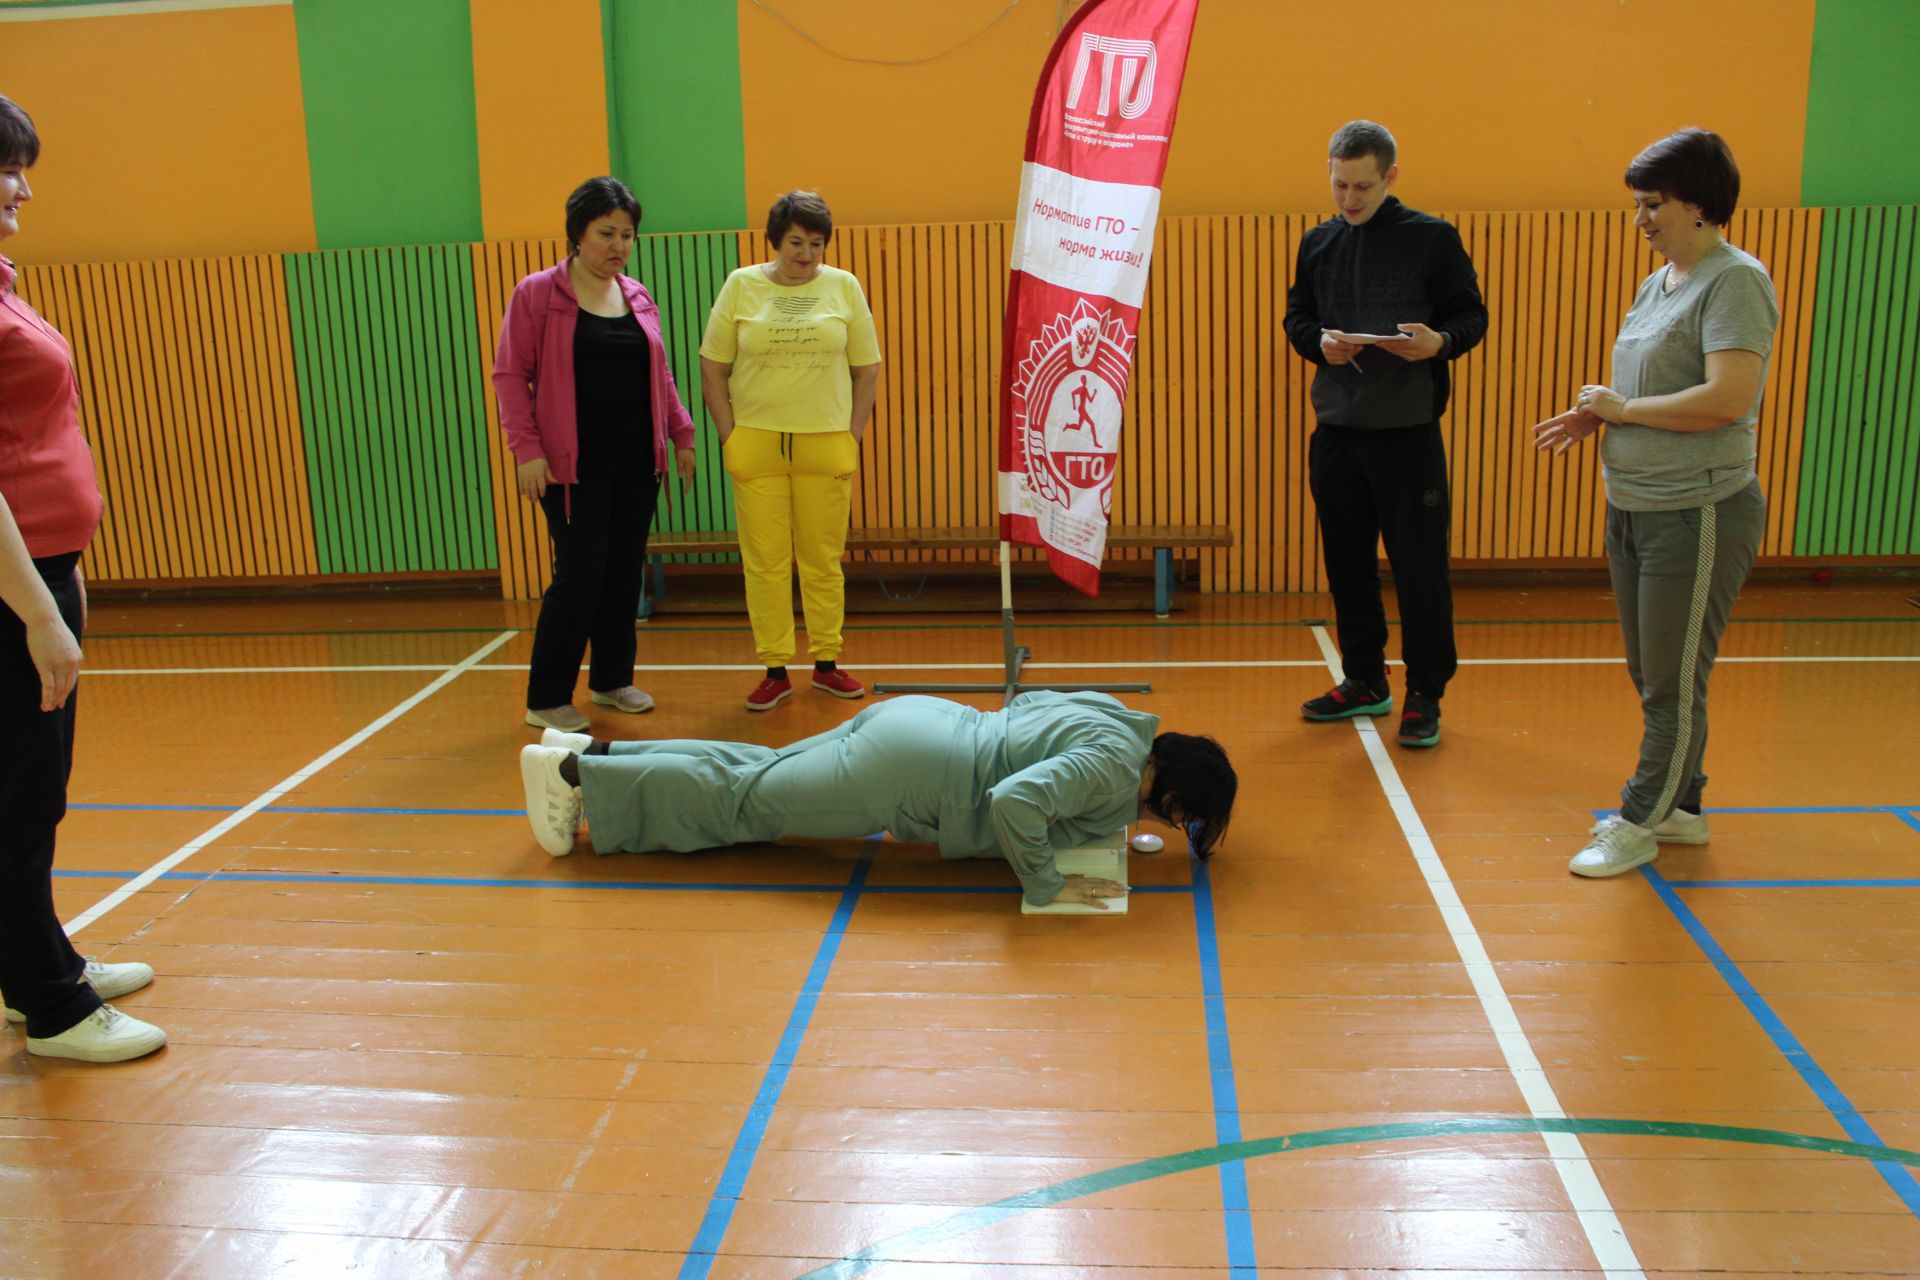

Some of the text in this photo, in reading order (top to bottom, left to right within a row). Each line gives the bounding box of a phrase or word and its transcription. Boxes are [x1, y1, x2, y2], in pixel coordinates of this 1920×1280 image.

[1066, 32, 1157, 119] ГТО
[1033, 197, 1091, 230] Норматив
[1095, 216, 1125, 234] ГТО
[1059, 237, 1144, 268] норма жизи!
[1065, 456, 1106, 481] ГТО
